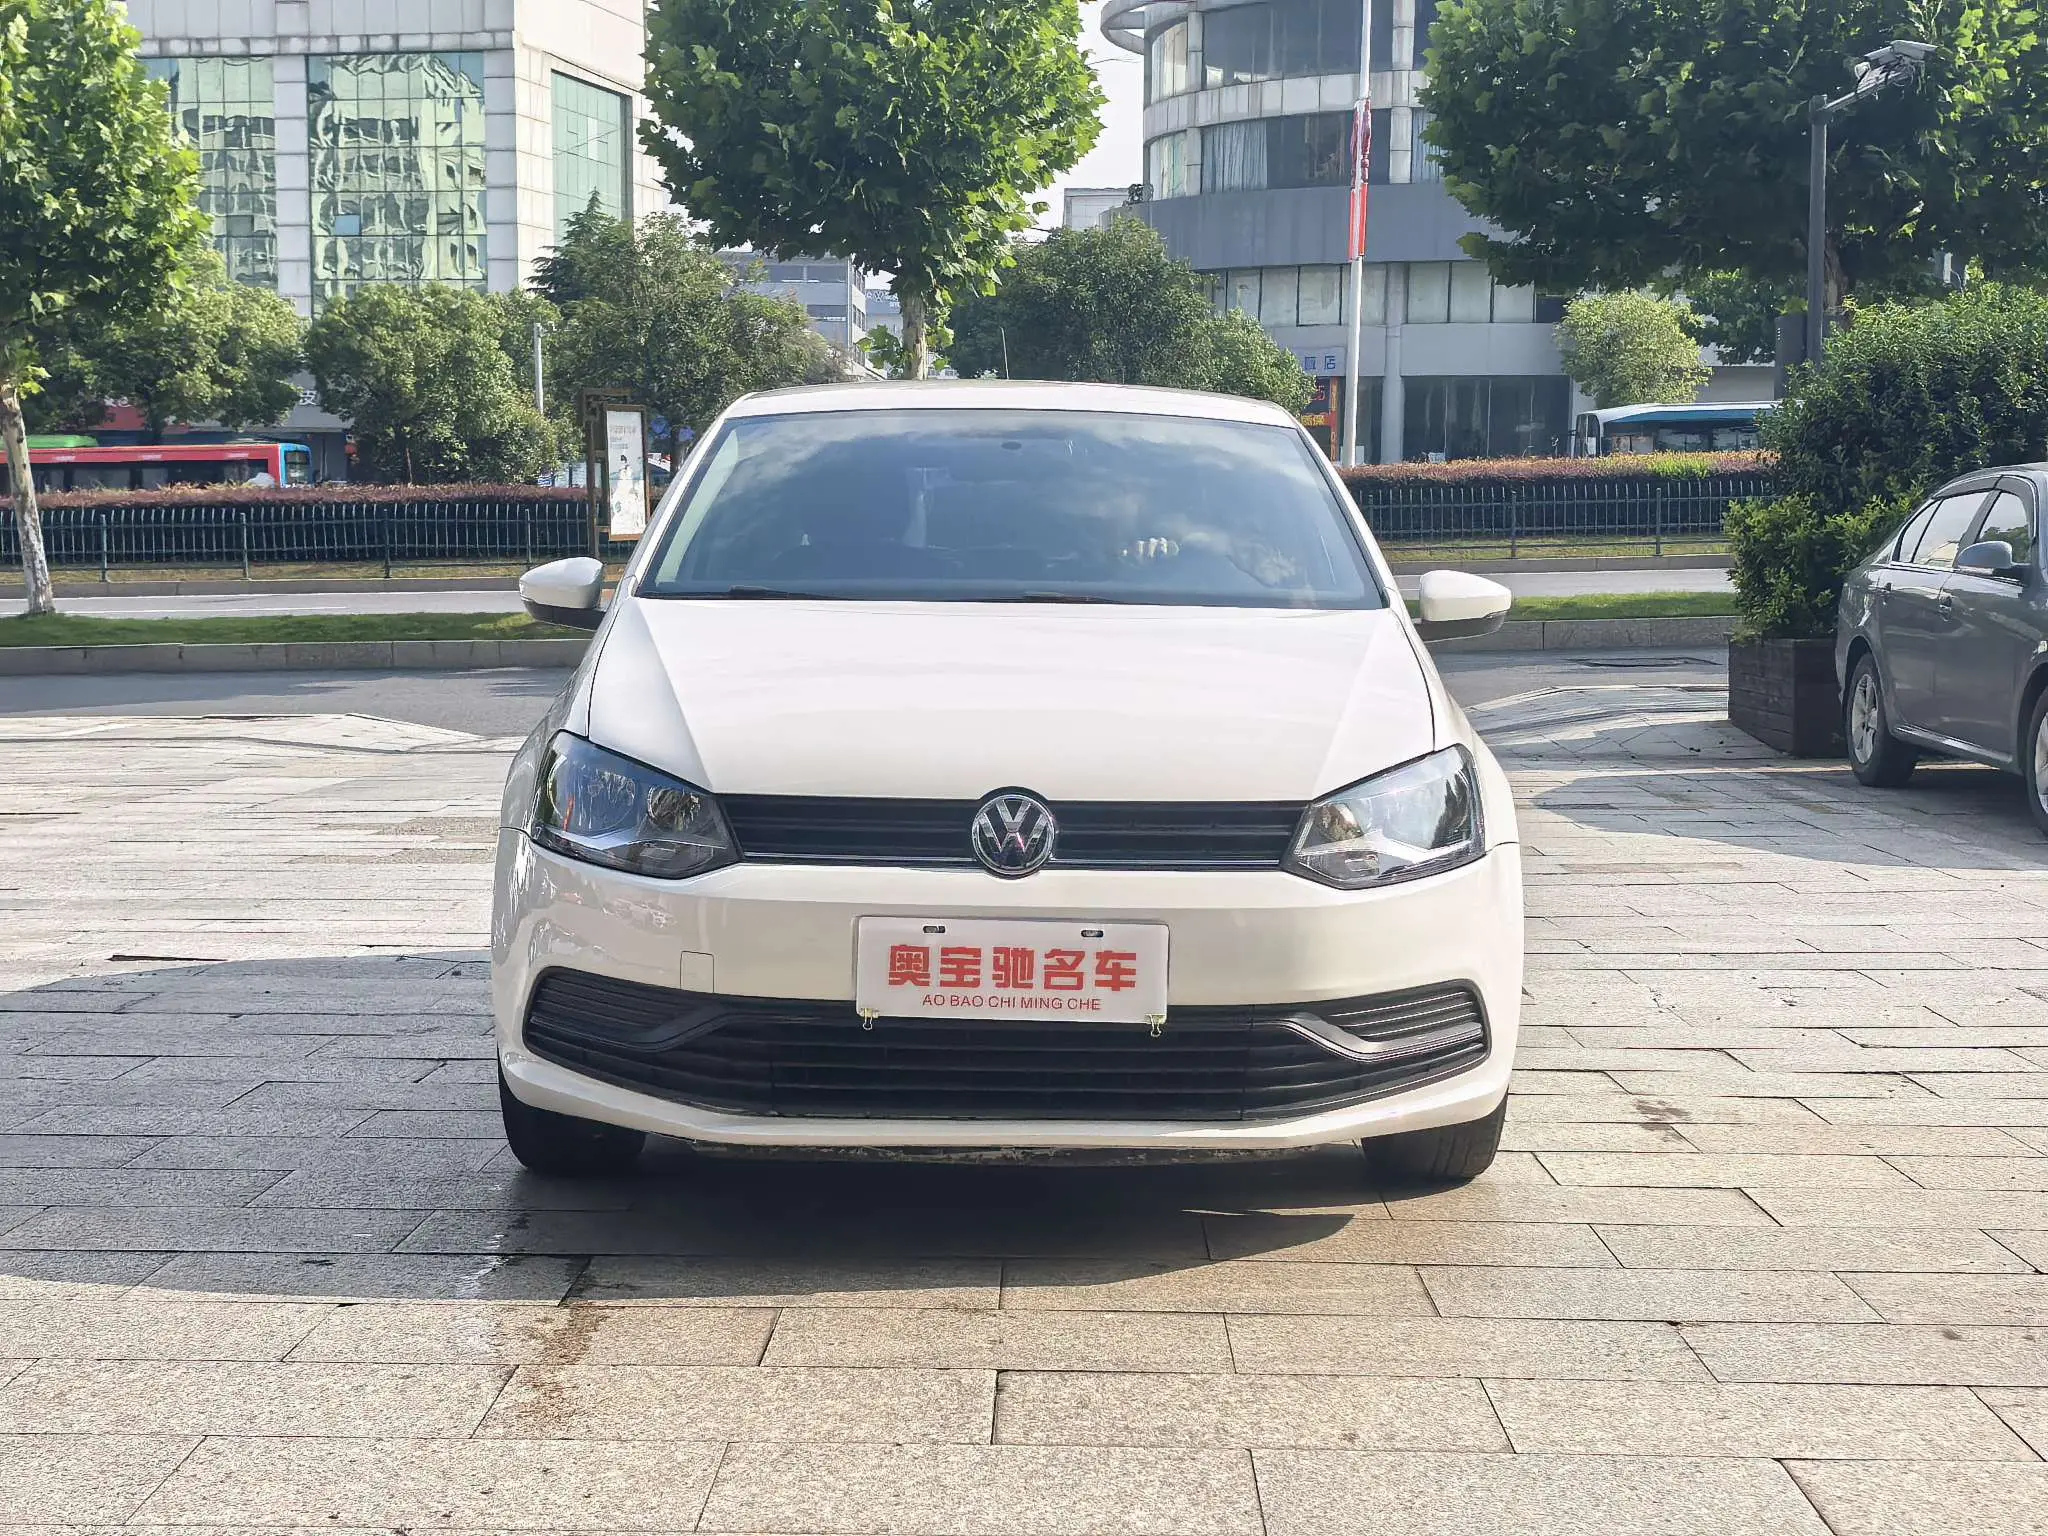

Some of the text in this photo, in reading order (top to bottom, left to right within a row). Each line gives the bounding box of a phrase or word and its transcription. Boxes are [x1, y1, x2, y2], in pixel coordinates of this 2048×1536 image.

[888, 944, 1137, 992] 奥宝驰名车
[922, 994, 1103, 1011] AO BAO CHI MING CHE
